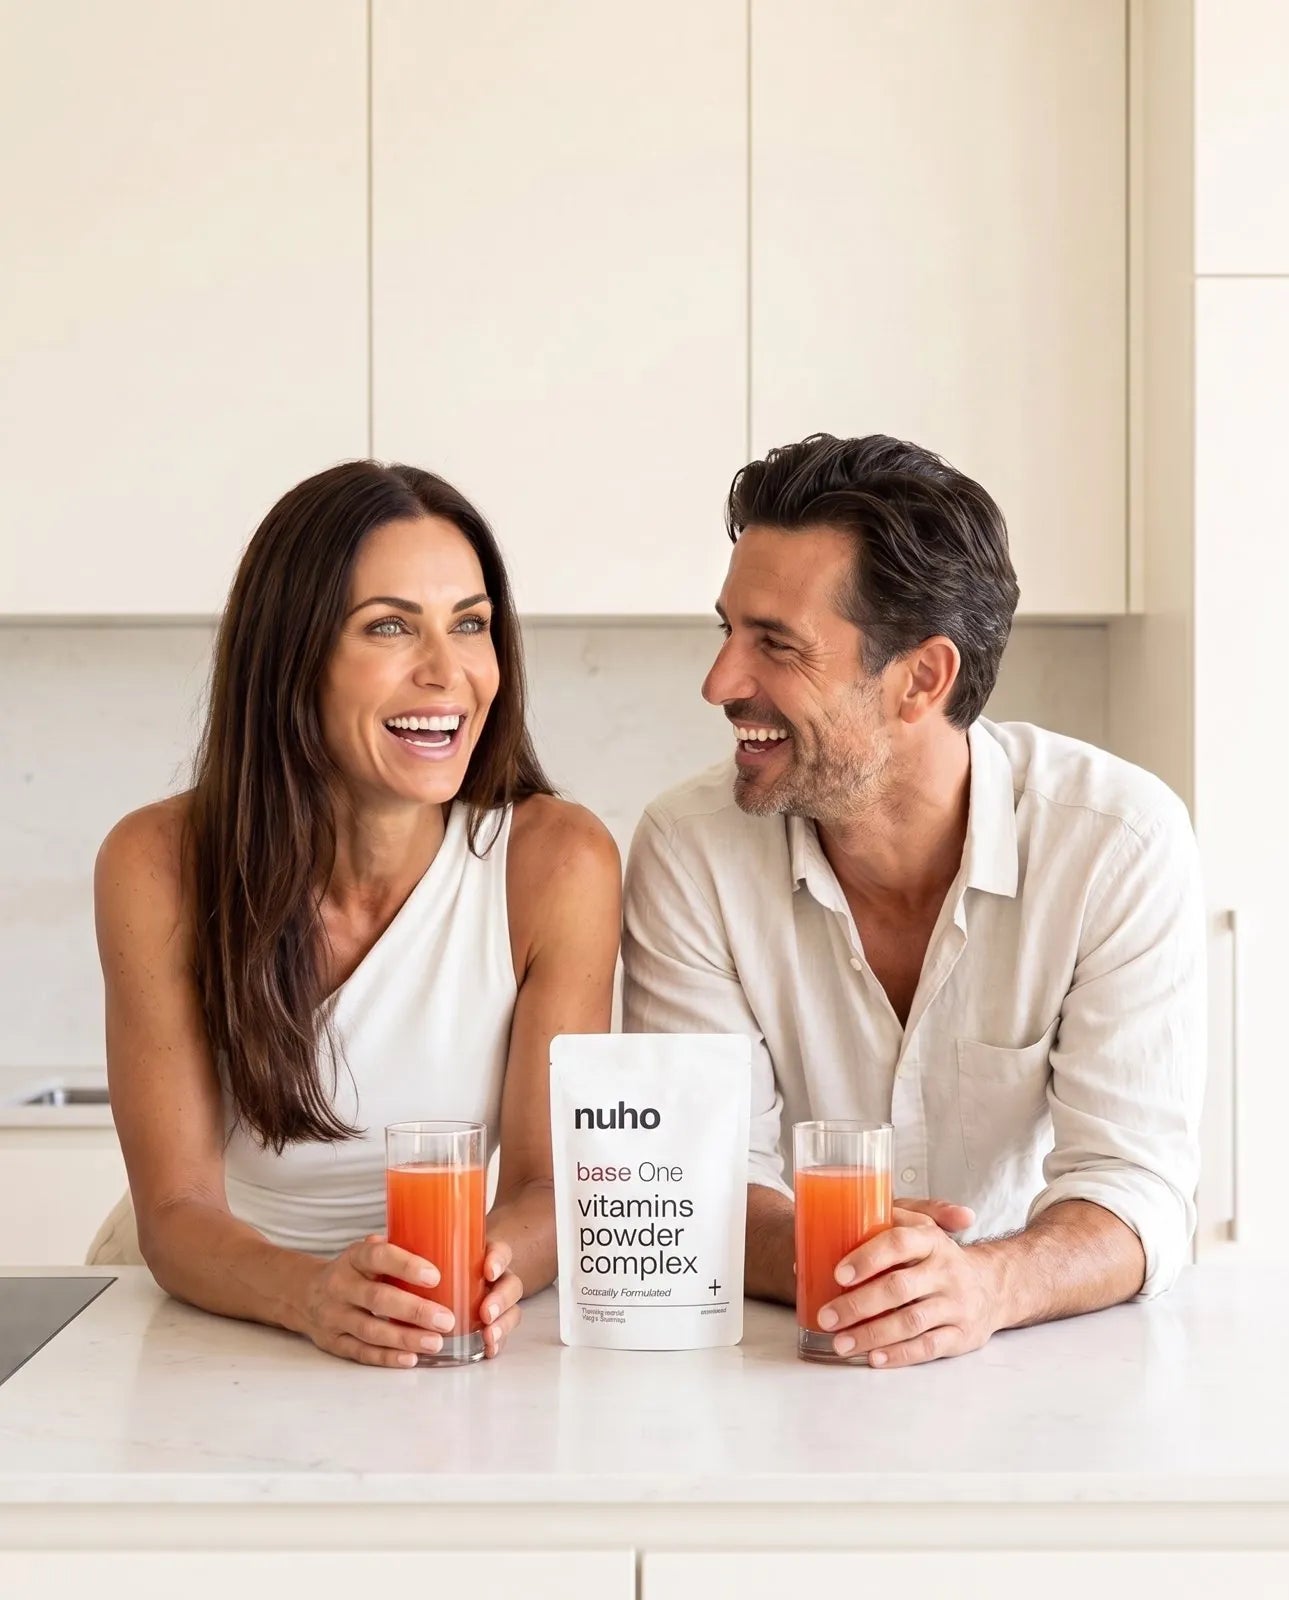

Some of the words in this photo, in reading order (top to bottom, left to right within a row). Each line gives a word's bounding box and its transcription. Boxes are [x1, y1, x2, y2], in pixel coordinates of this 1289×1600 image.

[574, 1100, 661, 1130] nuho
[577, 1161, 632, 1182] base
[638, 1161, 684, 1183] One
[577, 1193, 694, 1218] vitamins
[579, 1222, 685, 1253] powder
[579, 1249, 699, 1282] complex
[620, 1287, 672, 1298] Formulated
